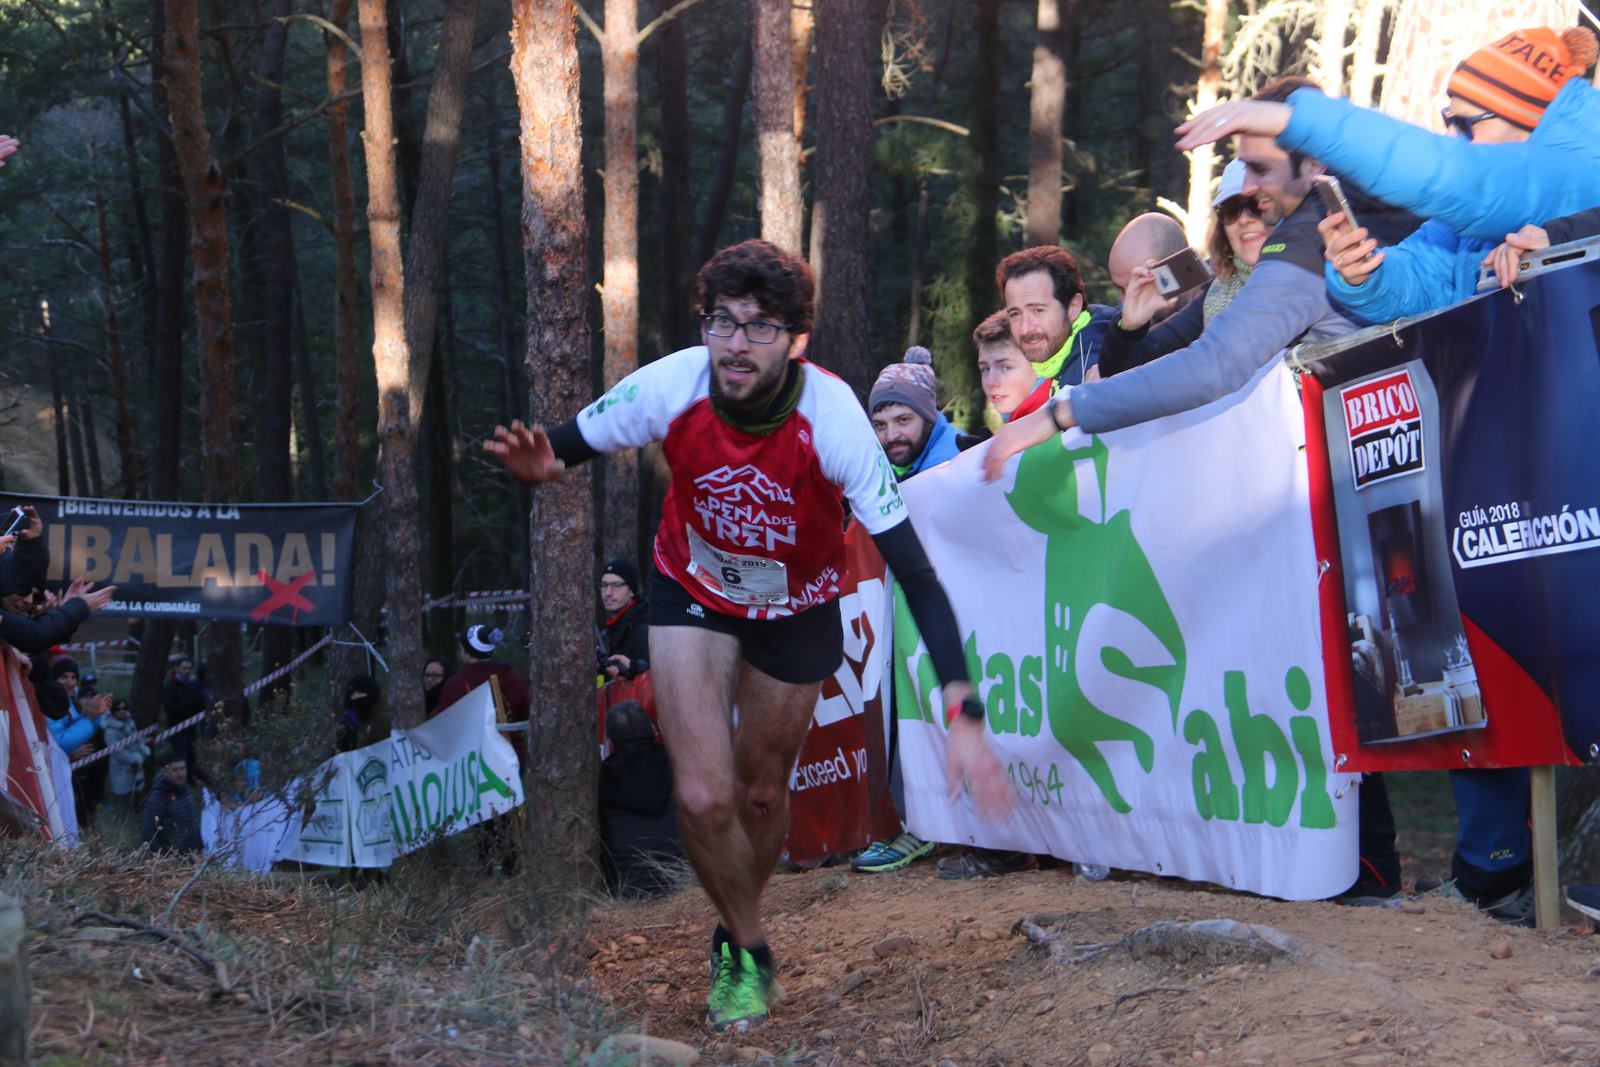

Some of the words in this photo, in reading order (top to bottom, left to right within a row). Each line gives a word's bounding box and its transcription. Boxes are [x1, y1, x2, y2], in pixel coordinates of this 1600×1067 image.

[1347, 382, 1415, 430] BRICO
[1354, 418, 1420, 478] DEPÔT
[197, 506, 212, 519] A
[216, 505, 241, 520] LA
[694, 496, 708, 509] LA
[708, 495, 771, 524] PEÑA
[771, 515, 796, 526] DEL
[695, 505, 796, 551] TREN
[1460, 505, 1489, 528] GUÍA
[1489, 501, 1520, 523] 2018
[721, 566, 742, 585] 6
[129, 601, 142, 611] LA
[796, 746, 851, 792] Exceed
[852, 747, 868, 783] yo
[1007, 762, 1064, 807] 1964
